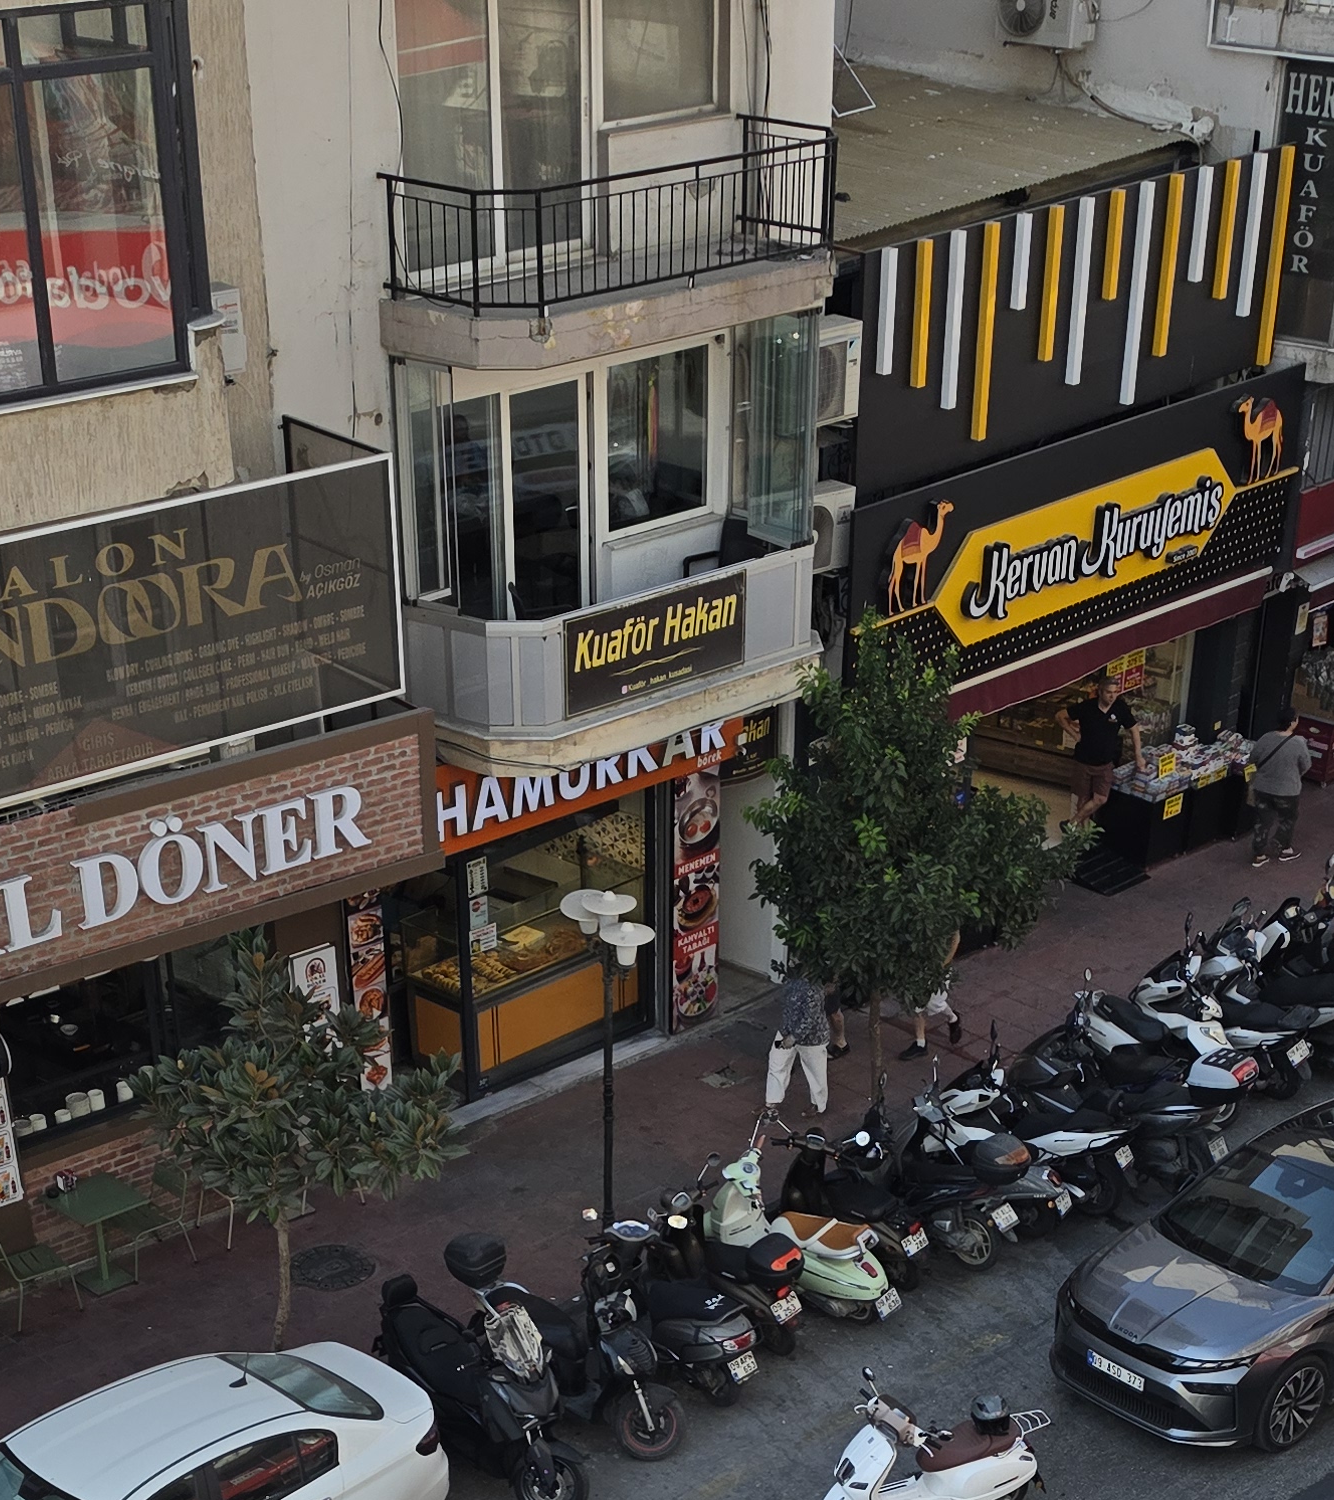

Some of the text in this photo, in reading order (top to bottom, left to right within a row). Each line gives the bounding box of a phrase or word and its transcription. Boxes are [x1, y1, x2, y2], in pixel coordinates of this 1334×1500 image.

[1290, 127, 1327, 273] KUAFÖR
[314, 557, 361, 579] Osman
[969, 539, 1077, 618] Kervan
[306, 573, 361, 600] AÇIKGÖZ
[574, 593, 737, 673] Kuaför Hakan
[82, 732, 114, 752] GİRİŞ
[697, 750, 722, 768] börek
[47, 762, 80, 782] ARKA
[71, 784, 373, 931] DÖNER
[678, 853, 716, 875] MENEMEN
[1127, 1372, 1143, 1389] 373
